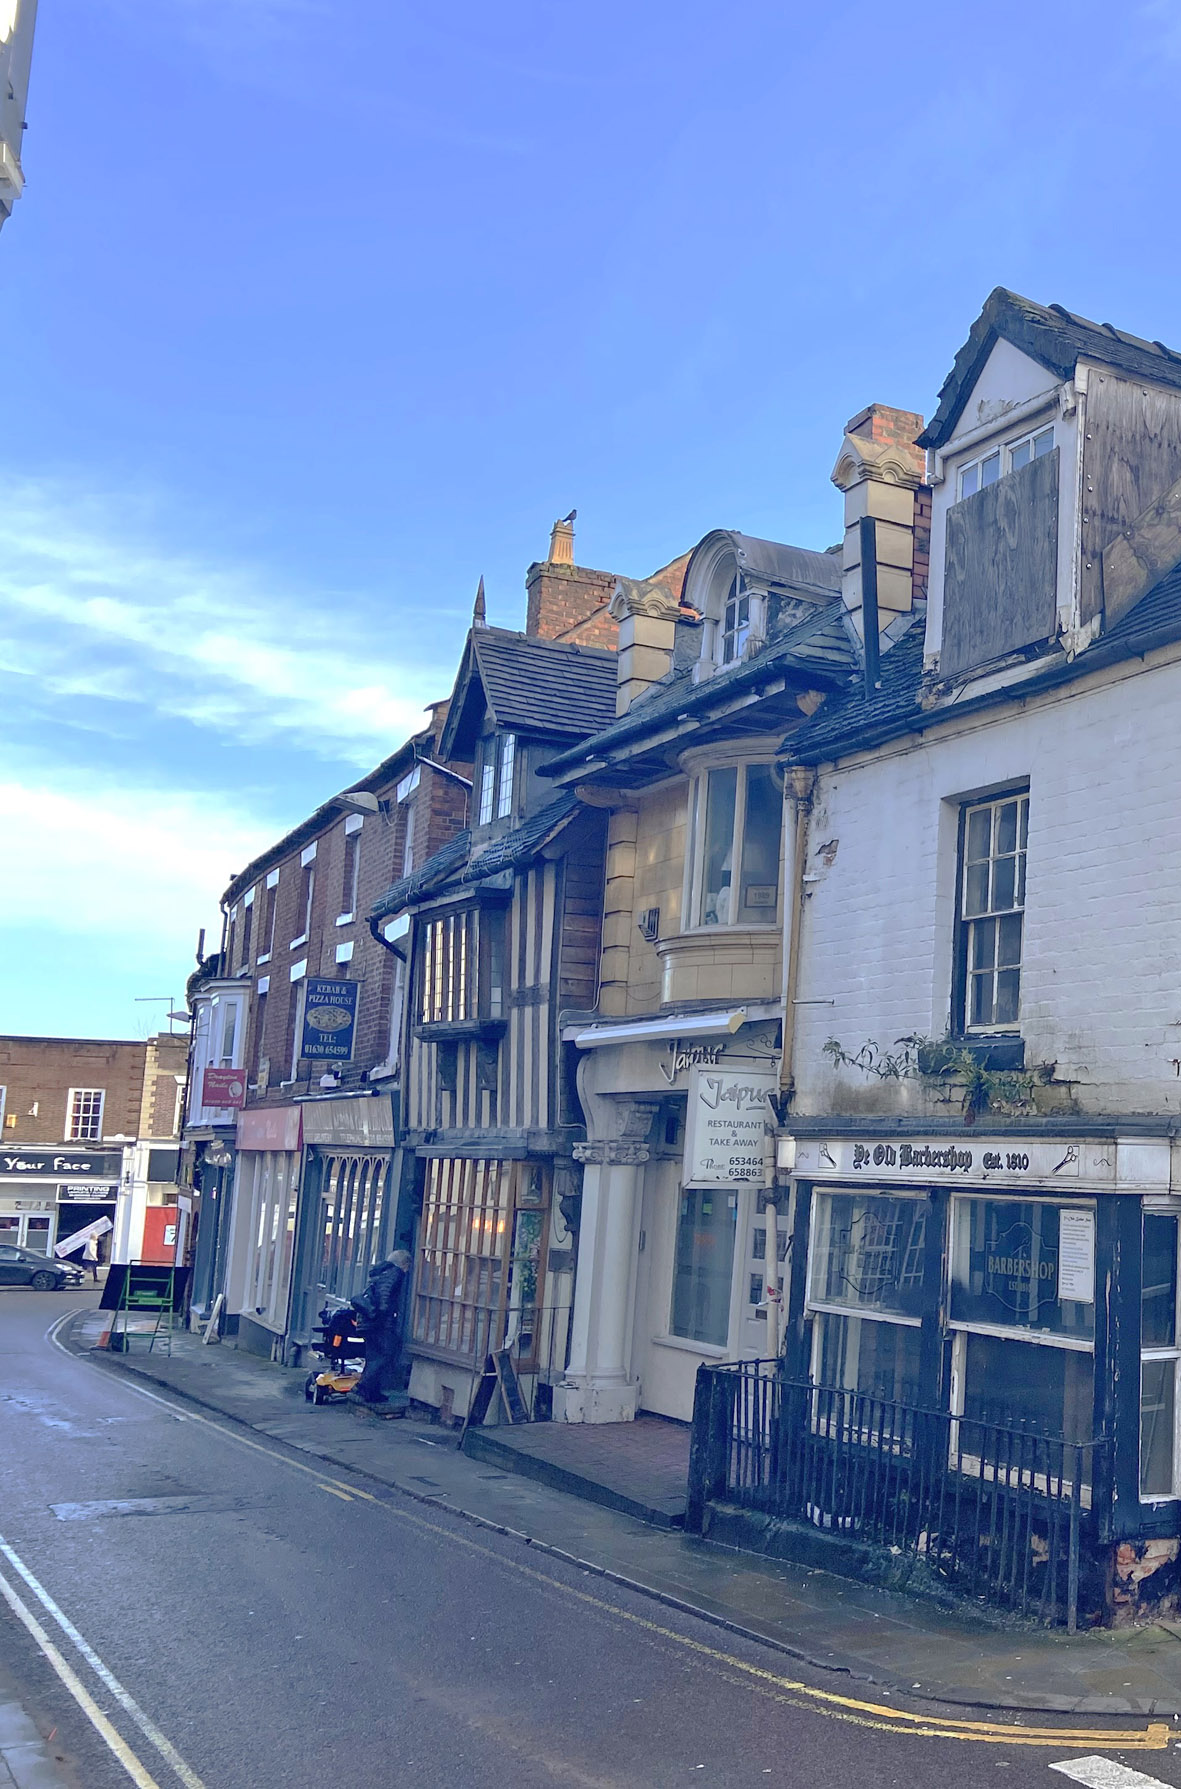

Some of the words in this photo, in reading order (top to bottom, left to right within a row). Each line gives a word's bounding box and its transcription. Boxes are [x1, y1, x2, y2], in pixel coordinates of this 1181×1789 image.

[317, 984, 340, 994] KEBAB
[340, 986, 347, 995] &
[308, 994, 329, 1004] PIZZA
[329, 996, 353, 1005] HOUSE
[304, 1044, 324, 1054] 01630
[700, 1078, 776, 1111] Jaipur
[707, 1120, 763, 1129] RESTAURANT
[731, 1130, 738, 1138] &
[709, 1138, 731, 1147] TAKE
[733, 1139, 759, 1148] AWAY
[729, 1156, 764, 1166] 653464
[853, 1143, 870, 1169] Ye
[872, 1143, 897, 1166] Old
[899, 1143, 973, 1173] Barbershop
[1006, 1152, 1030, 1171] 1810
[4, 1157, 45, 1170] Your
[53, 1157, 92, 1171] Face
[728, 1167, 763, 1177] 658863
[988, 1255, 1055, 1280] BARBERSHOP
